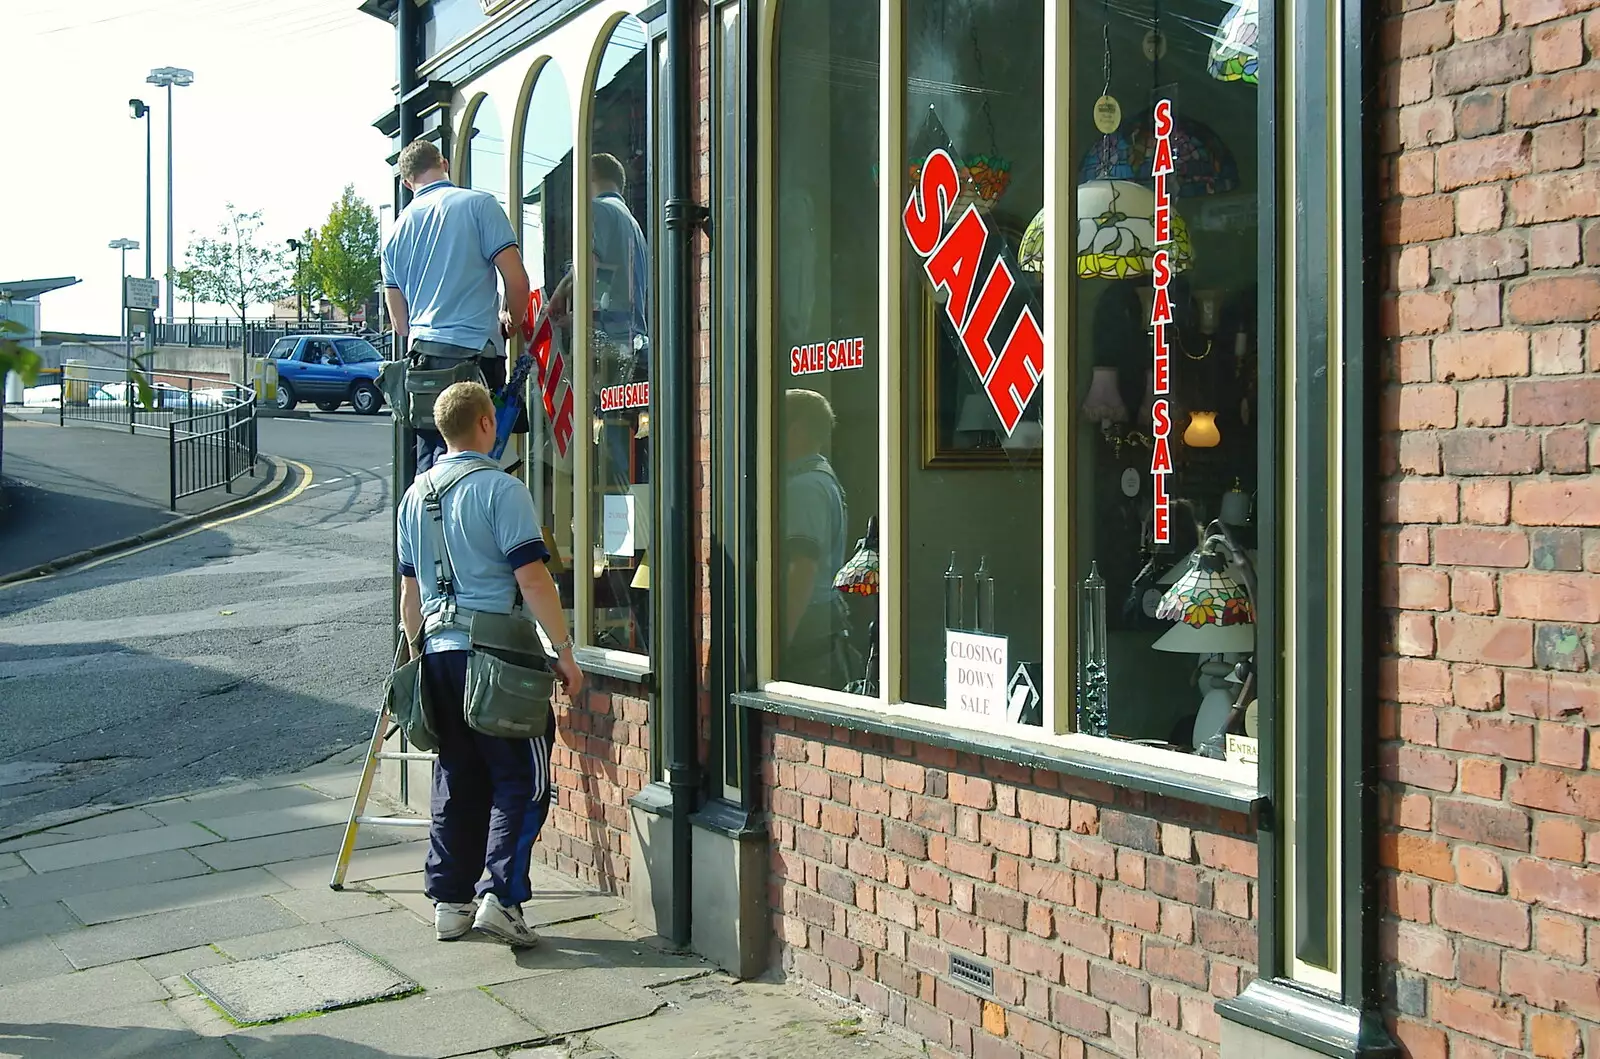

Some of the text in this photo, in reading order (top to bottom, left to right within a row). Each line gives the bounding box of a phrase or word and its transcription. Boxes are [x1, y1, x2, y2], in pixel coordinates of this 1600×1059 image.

[902, 148, 1044, 438] SALE
[1151, 99, 1174, 543] SALE SALE SALE
[791, 337, 863, 375] SALE SALE
[600, 382, 649, 412] SALE SALE
[950, 640, 1003, 665] CLOSING
[958, 667, 995, 689] DOWN
[960, 694, 990, 715] SALE
